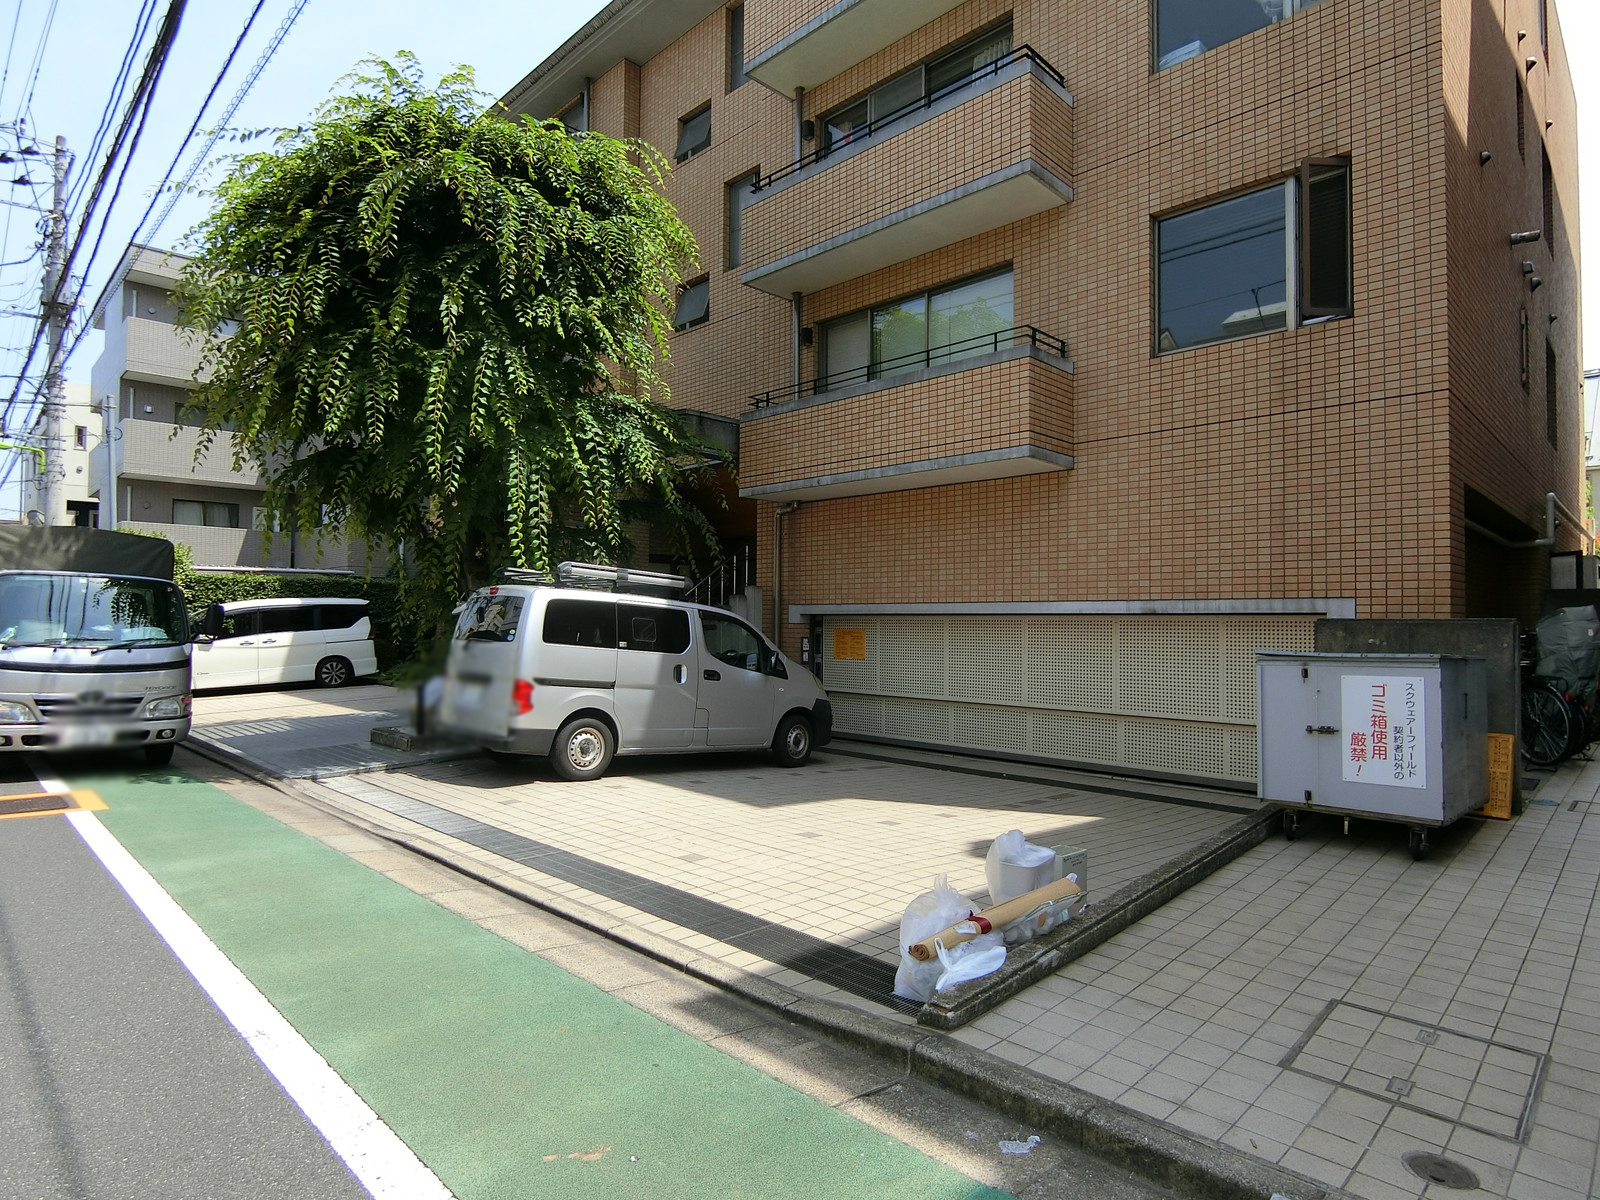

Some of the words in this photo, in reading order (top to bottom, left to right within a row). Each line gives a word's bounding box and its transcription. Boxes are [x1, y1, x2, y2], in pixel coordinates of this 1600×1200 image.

[1371, 683, 1388, 760] ゴミ箱使用
[1393, 727, 1404, 780] 契約者以外の
[1405, 683, 1417, 777] スクウェアーフィールド
